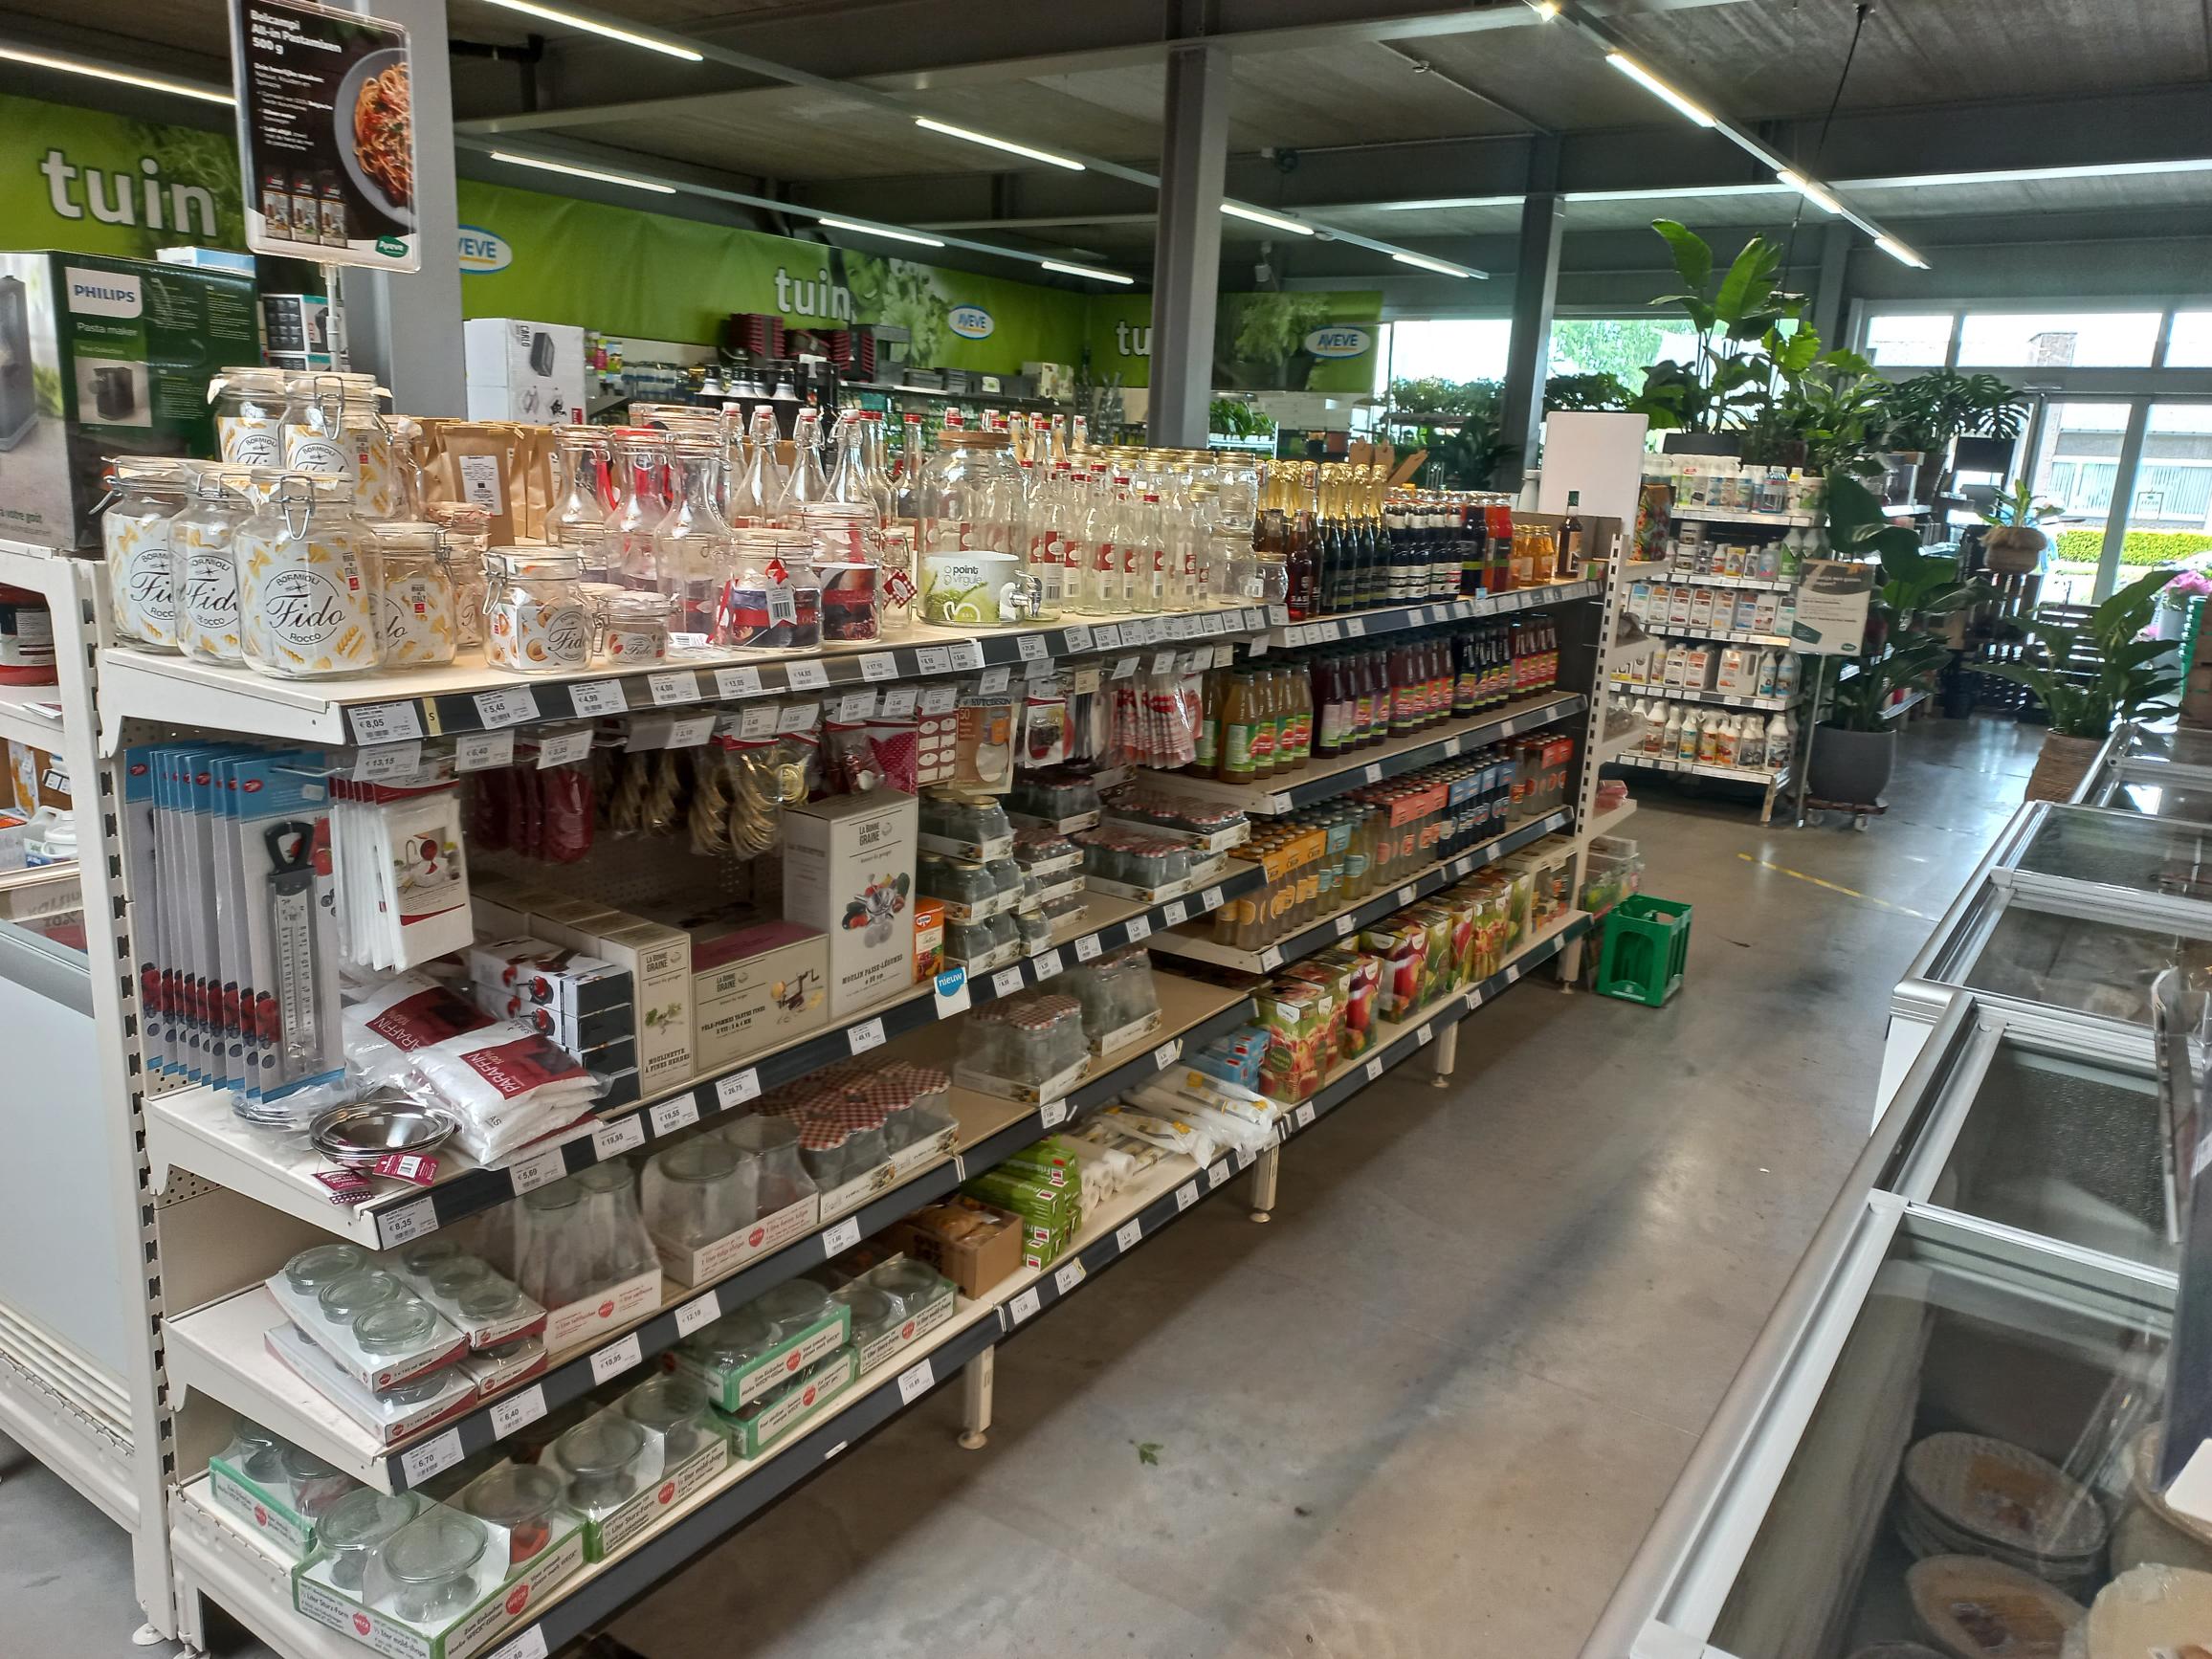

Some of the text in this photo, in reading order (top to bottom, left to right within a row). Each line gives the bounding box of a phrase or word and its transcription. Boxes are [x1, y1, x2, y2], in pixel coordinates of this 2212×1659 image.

[250, 10, 300, 32] Belcampi
[252, 24, 281, 39] All-in
[252, 36, 284, 55] 500 g
[40, 149, 217, 237] tuin
[75, 284, 136, 303] PHILIPS
[773, 267, 853, 321] tuin
[958, 313, 986, 328] AVEVE
[77, 321, 138, 336] Pasta maker
[520, 325, 531, 347] CARLO
[1317, 333, 1359, 347] AVEVE
[953, 564, 979, 576] point
[276, 572, 320, 586] BORMIOLI
[266, 593, 346, 629] Fido
[290, 632, 321, 643] ROCCO
[489, 702, 506, 714] 5,45
[429, 712, 435, 721] S
[365, 719, 385, 730] 8,05
[372, 757, 395, 767] 13,15
[646, 955, 653, 963] LA
[646, 959, 668, 973] GRAINE
[717, 980, 737, 993] GRAINE
[938, 973, 963, 987] nieuw
[467, 1052, 521, 1093] PARAFFIN
[394, 1217, 412, 1231] 8,35
[504, 1408, 520, 1421] 6,40
[417, 1453, 435, 1469] 6,70
[448, 1639, 467, 1656] Marke
